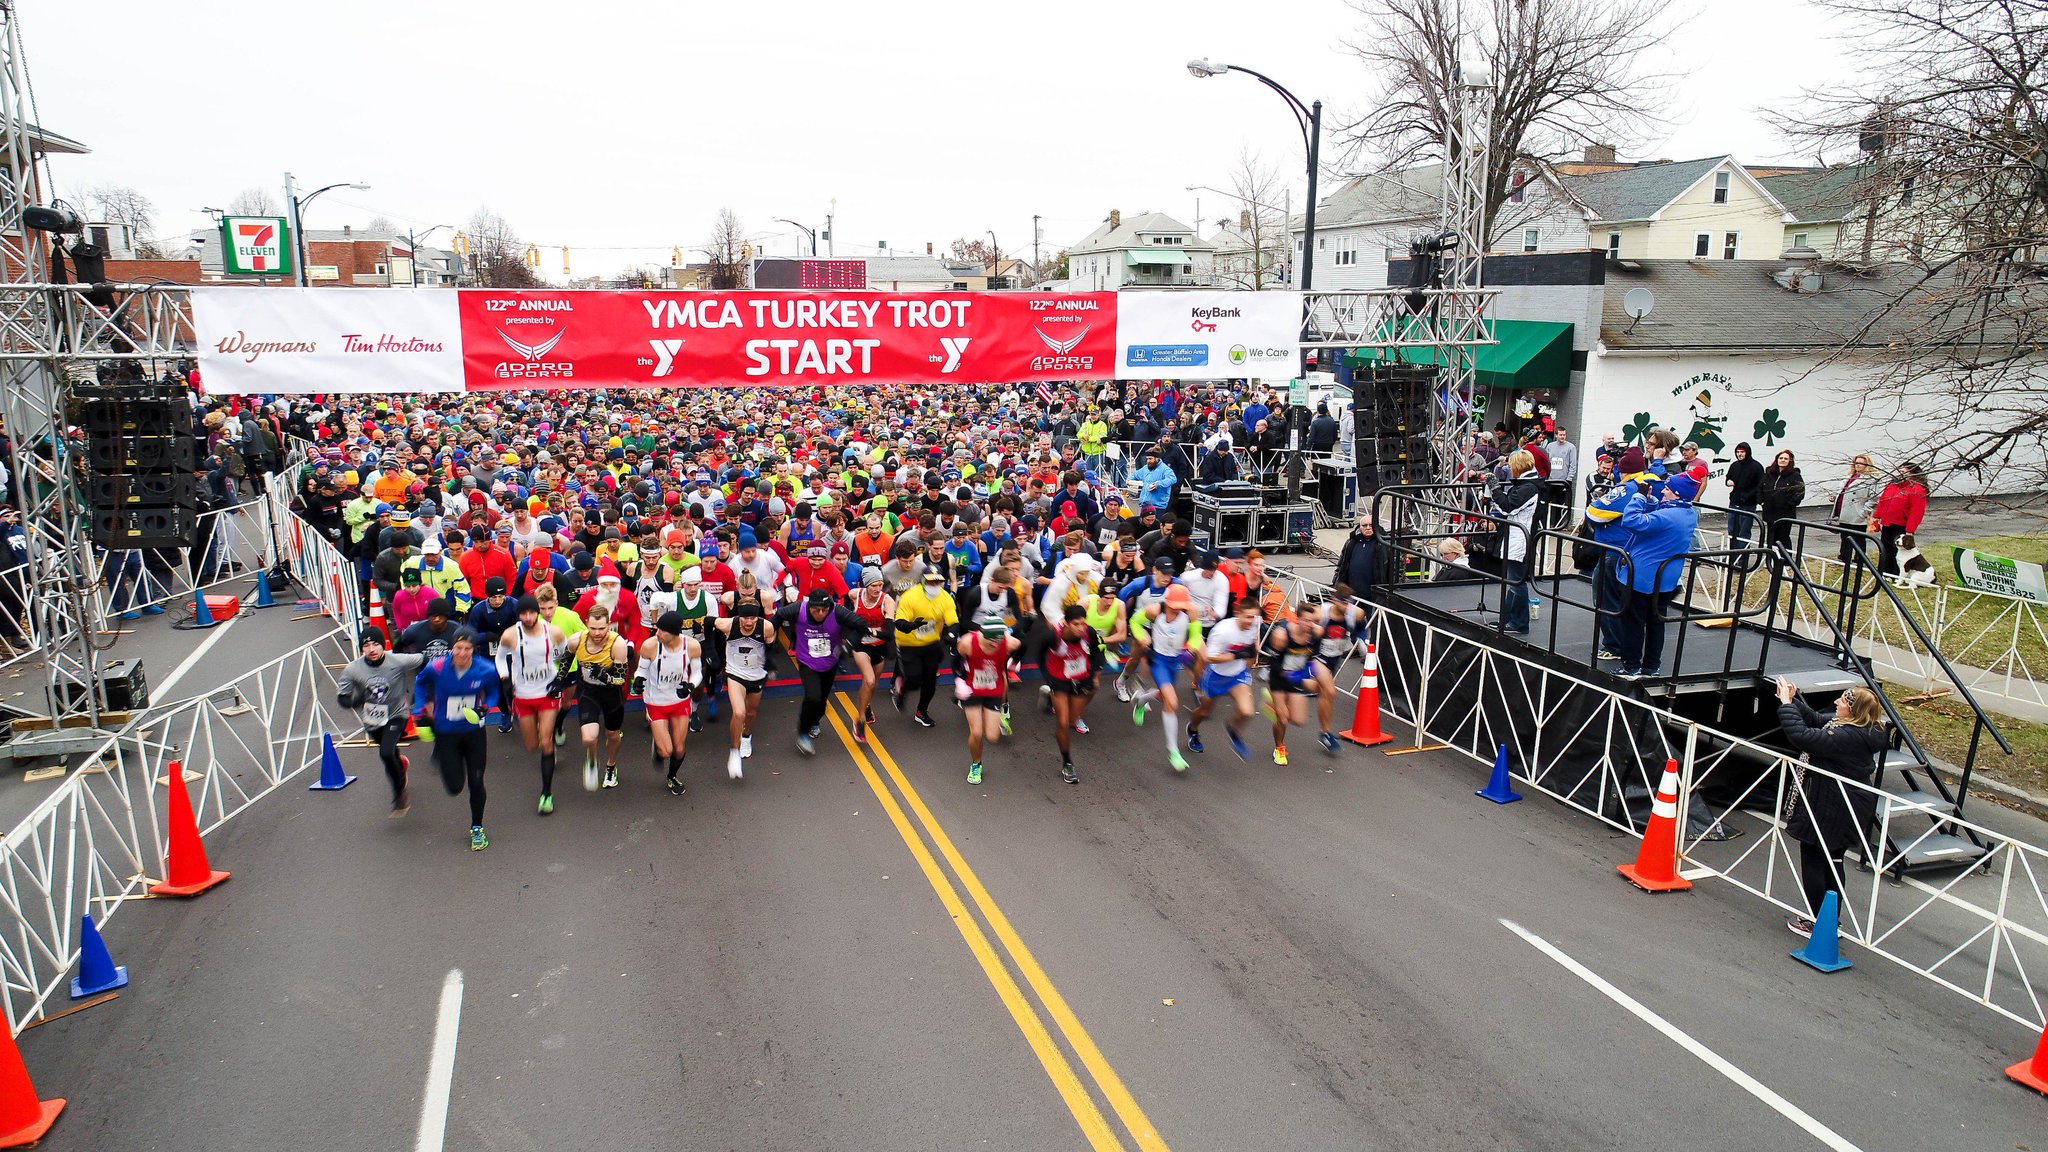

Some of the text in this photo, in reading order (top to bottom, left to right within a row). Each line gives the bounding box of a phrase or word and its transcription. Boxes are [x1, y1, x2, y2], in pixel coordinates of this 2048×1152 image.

[239, 225, 273, 270] 7
[485, 300, 574, 311] 122ND ANNUAL
[1029, 300, 1099, 310] 122ND ANNUAL
[642, 299, 972, 329] YMCA TURKEY TROT
[1074, 315, 1082, 323] by
[1191, 307, 1241, 320] KeyBank
[505, 316, 555, 325] presented by
[213, 330, 317, 363] Wegmans
[341, 333, 444, 353] Tim Hortons
[745, 338, 881, 376] START
[928, 354, 943, 362] the
[1249, 348, 1289, 357] We Care
[637, 356, 653, 366] the
[1981, 572, 2016, 587] ROOFING
